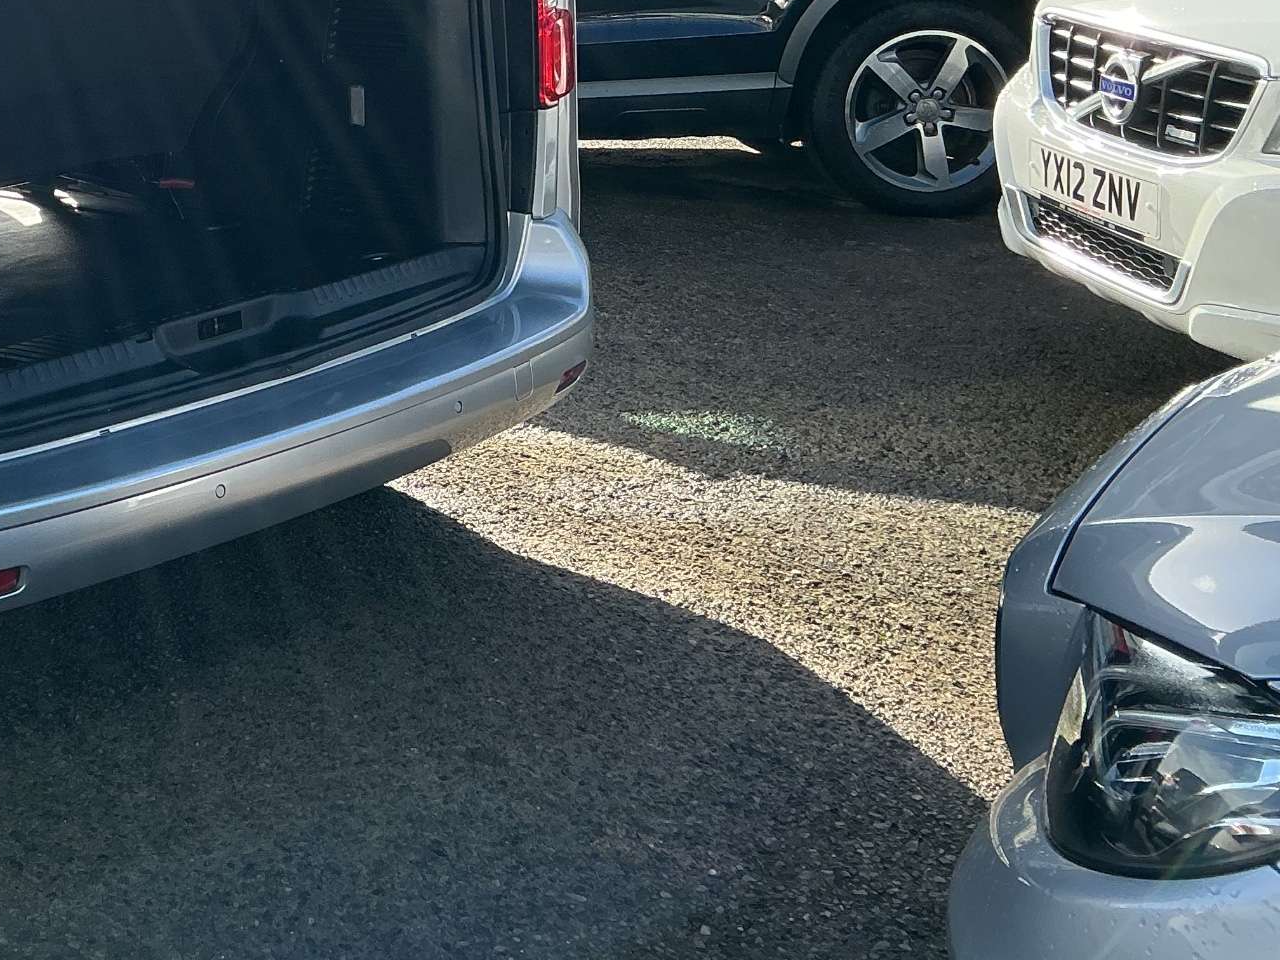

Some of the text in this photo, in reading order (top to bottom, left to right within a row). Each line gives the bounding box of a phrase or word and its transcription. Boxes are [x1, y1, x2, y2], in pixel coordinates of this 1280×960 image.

[1101, 78, 1133, 96] VOLVO
[1041, 148, 1085, 203] YX12
[1092, 168, 1141, 222] ZNV
